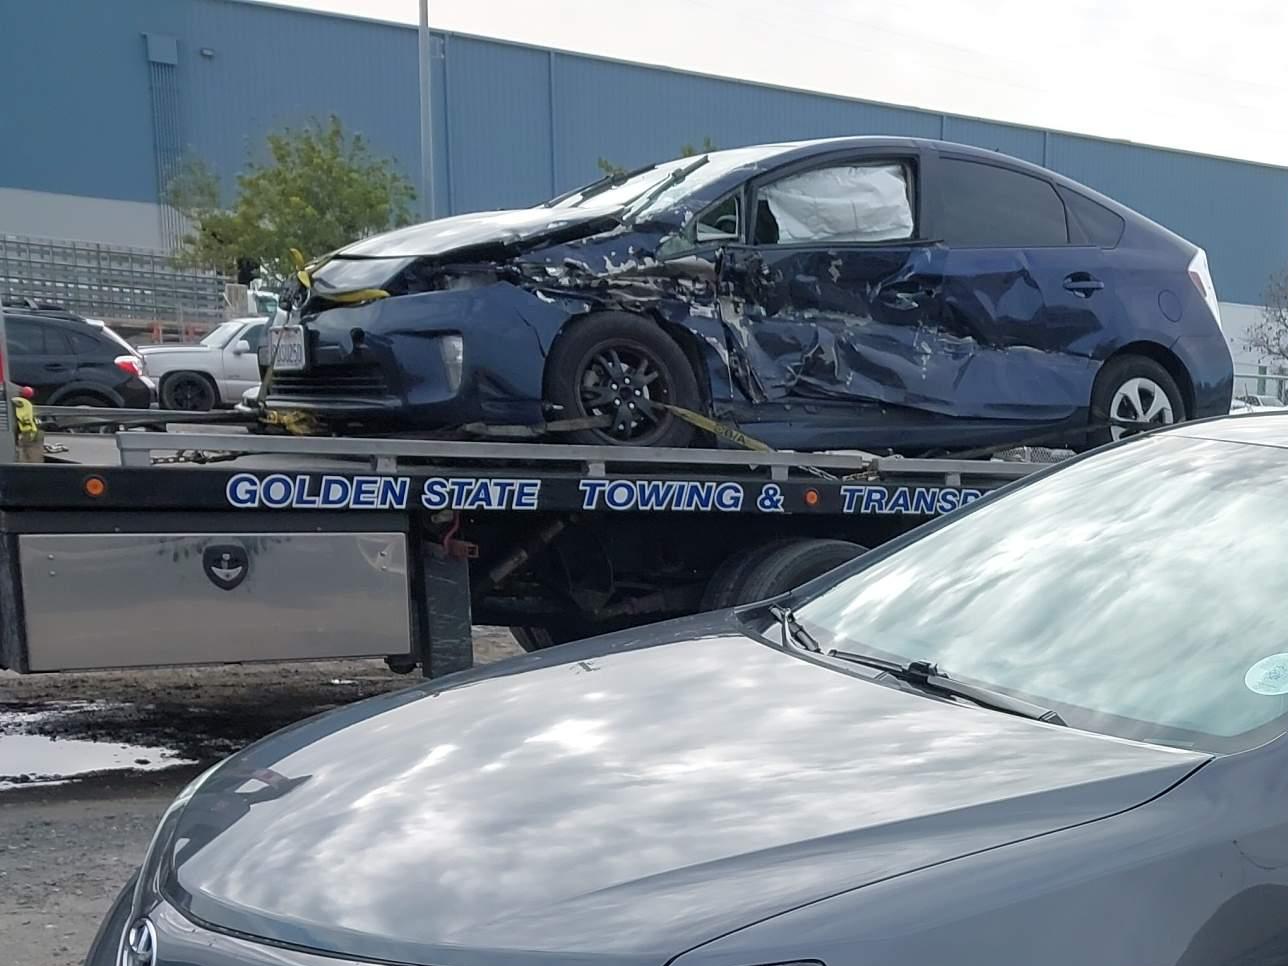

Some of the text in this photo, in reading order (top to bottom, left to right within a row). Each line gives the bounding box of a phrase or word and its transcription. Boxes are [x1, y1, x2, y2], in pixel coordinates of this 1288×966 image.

[226, 473, 996, 515] GOLDEN STATE TOWING & TRANSP
